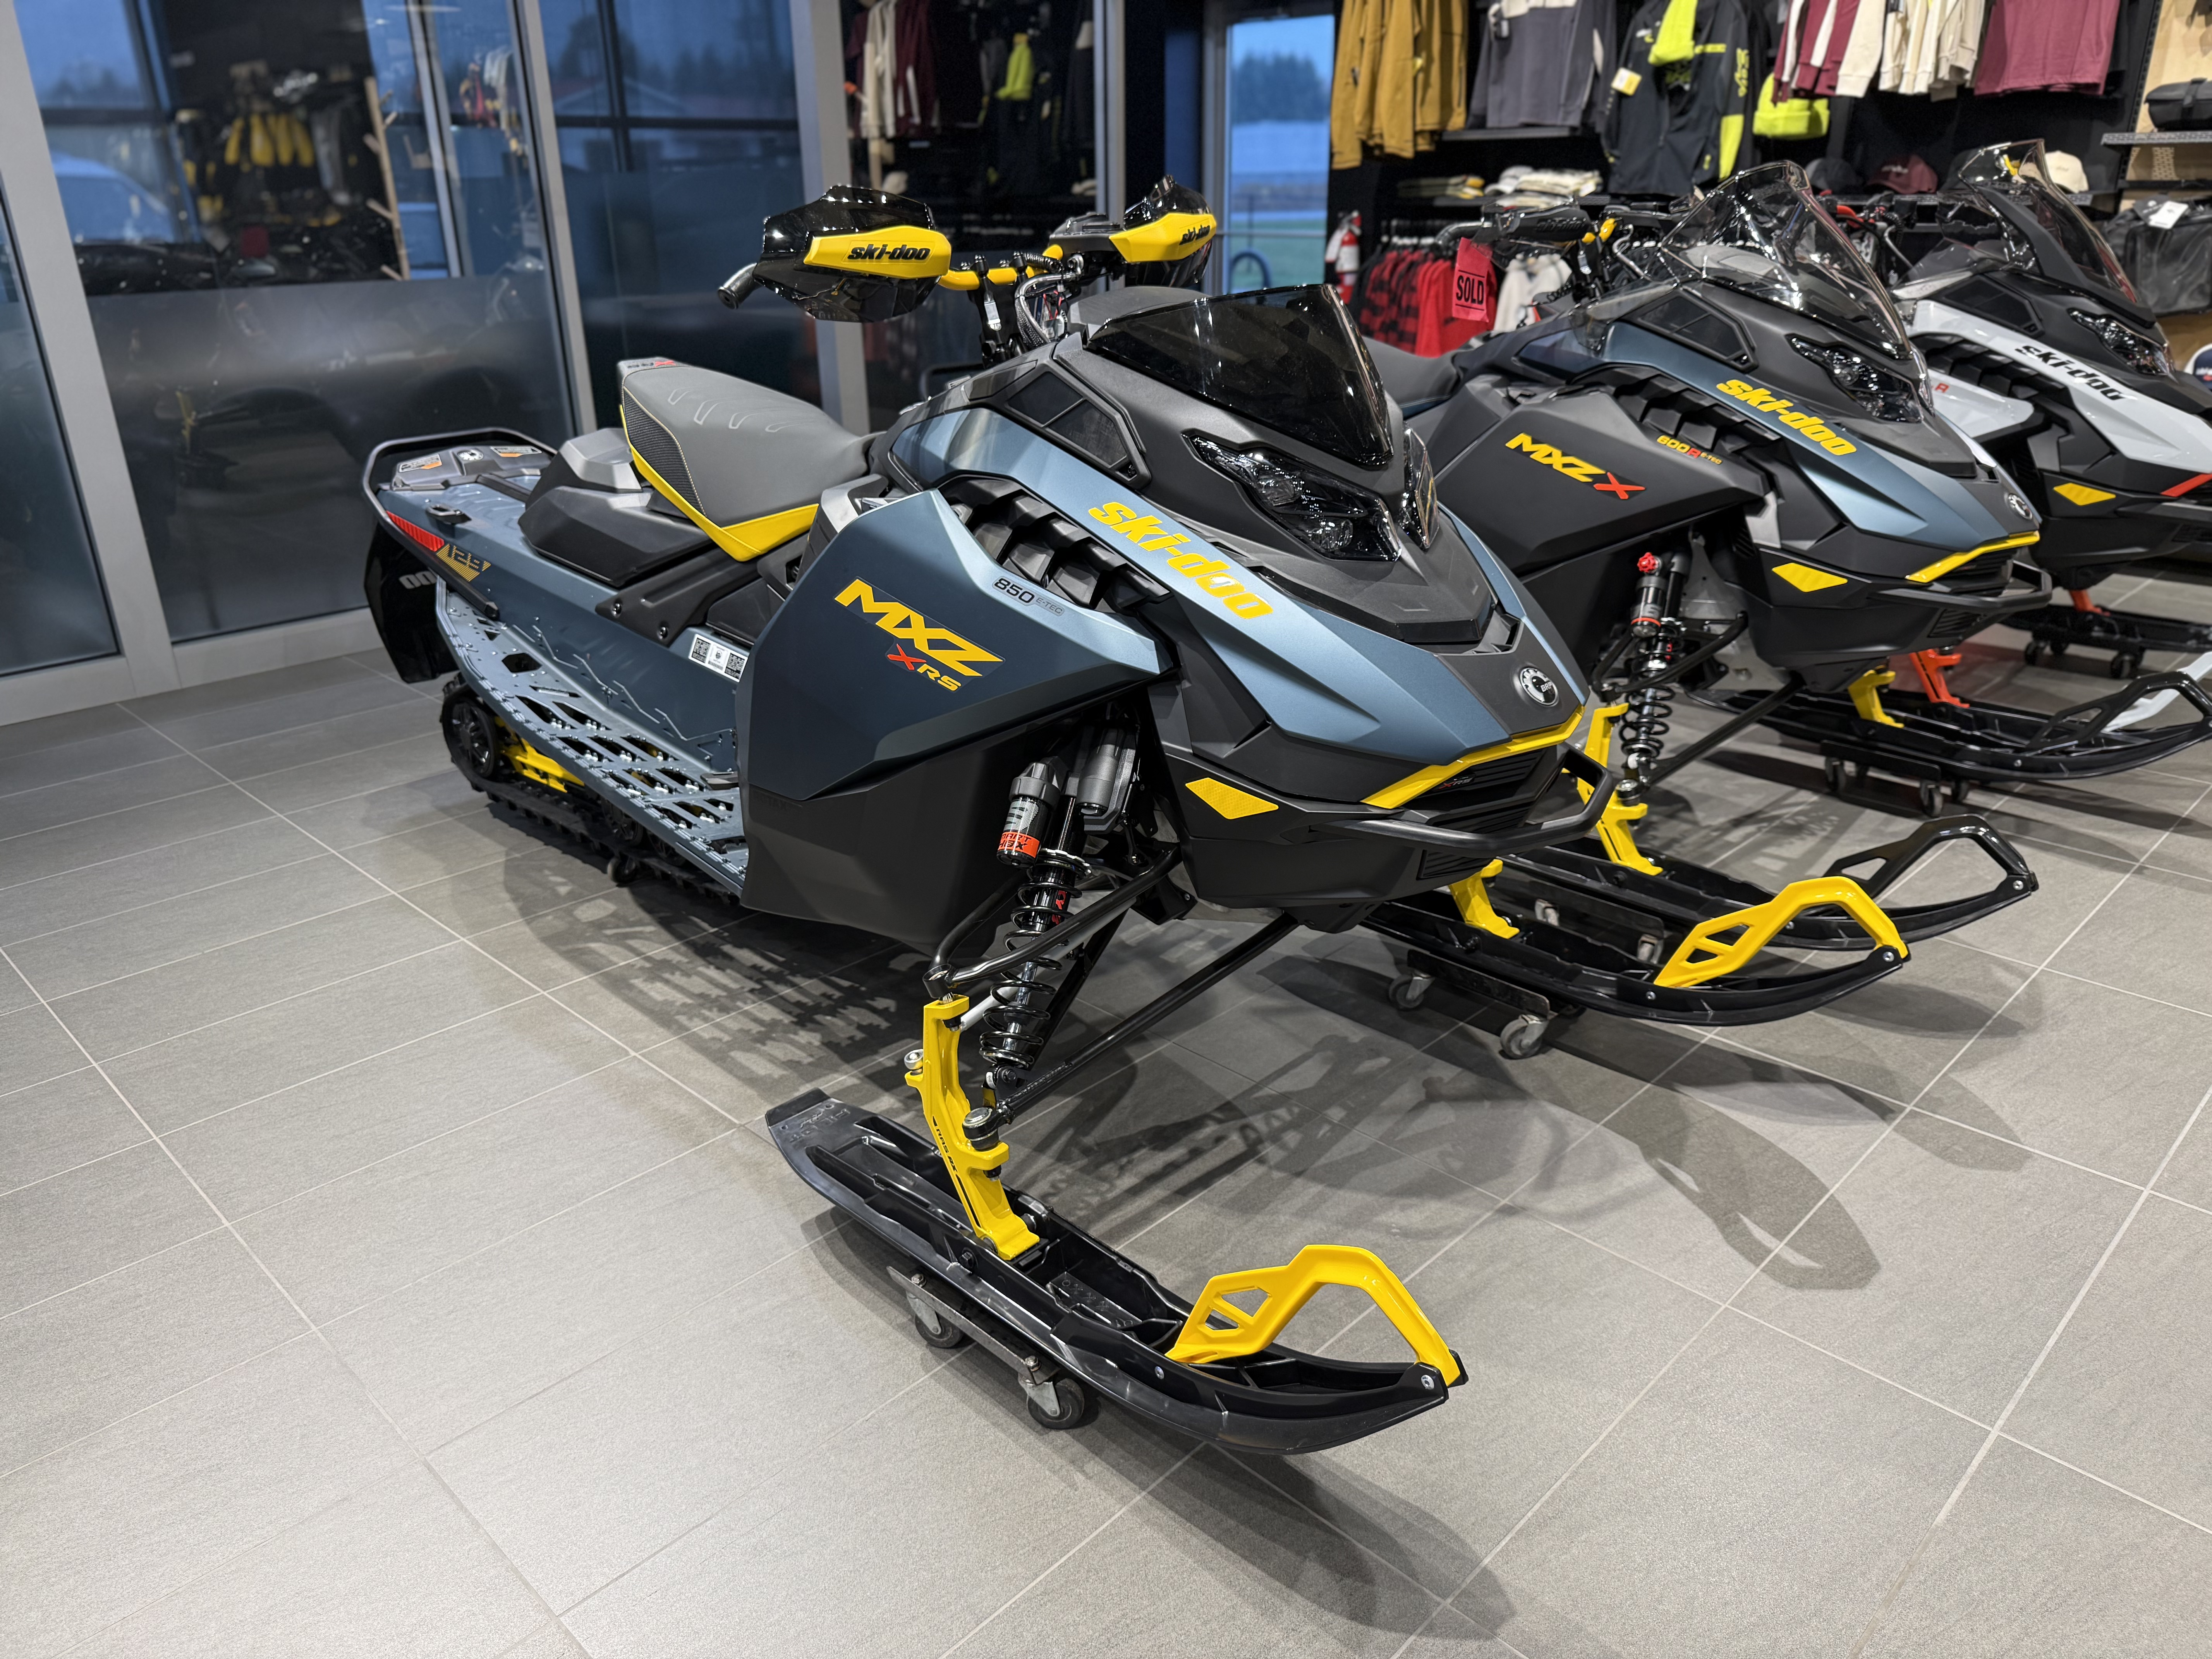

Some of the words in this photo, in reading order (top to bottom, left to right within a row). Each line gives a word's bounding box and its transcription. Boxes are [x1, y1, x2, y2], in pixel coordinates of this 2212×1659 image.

[1178, 224, 1210, 246] ski-doo
[847, 244, 931, 261] ski-doo
[1456, 275, 1484, 305] SOLD
[2014, 345, 2126, 401] ski-doo
[1716, 379, 1858, 456] ski-doo
[1657, 435, 1702, 459] 600R
[1505, 432, 1606, 483] MXZ
[1593, 472, 1646, 500] X
[1088, 502, 1274, 620] ski-doo
[994, 578, 1035, 603] 850
[1036, 598, 1063, 614] E-TEC
[834, 579, 1003, 677] MXZ
[1540, 682, 1553, 692] BRP
[1001, 833, 1032, 842] MART
[936, 1128, 950, 1154] RAS
